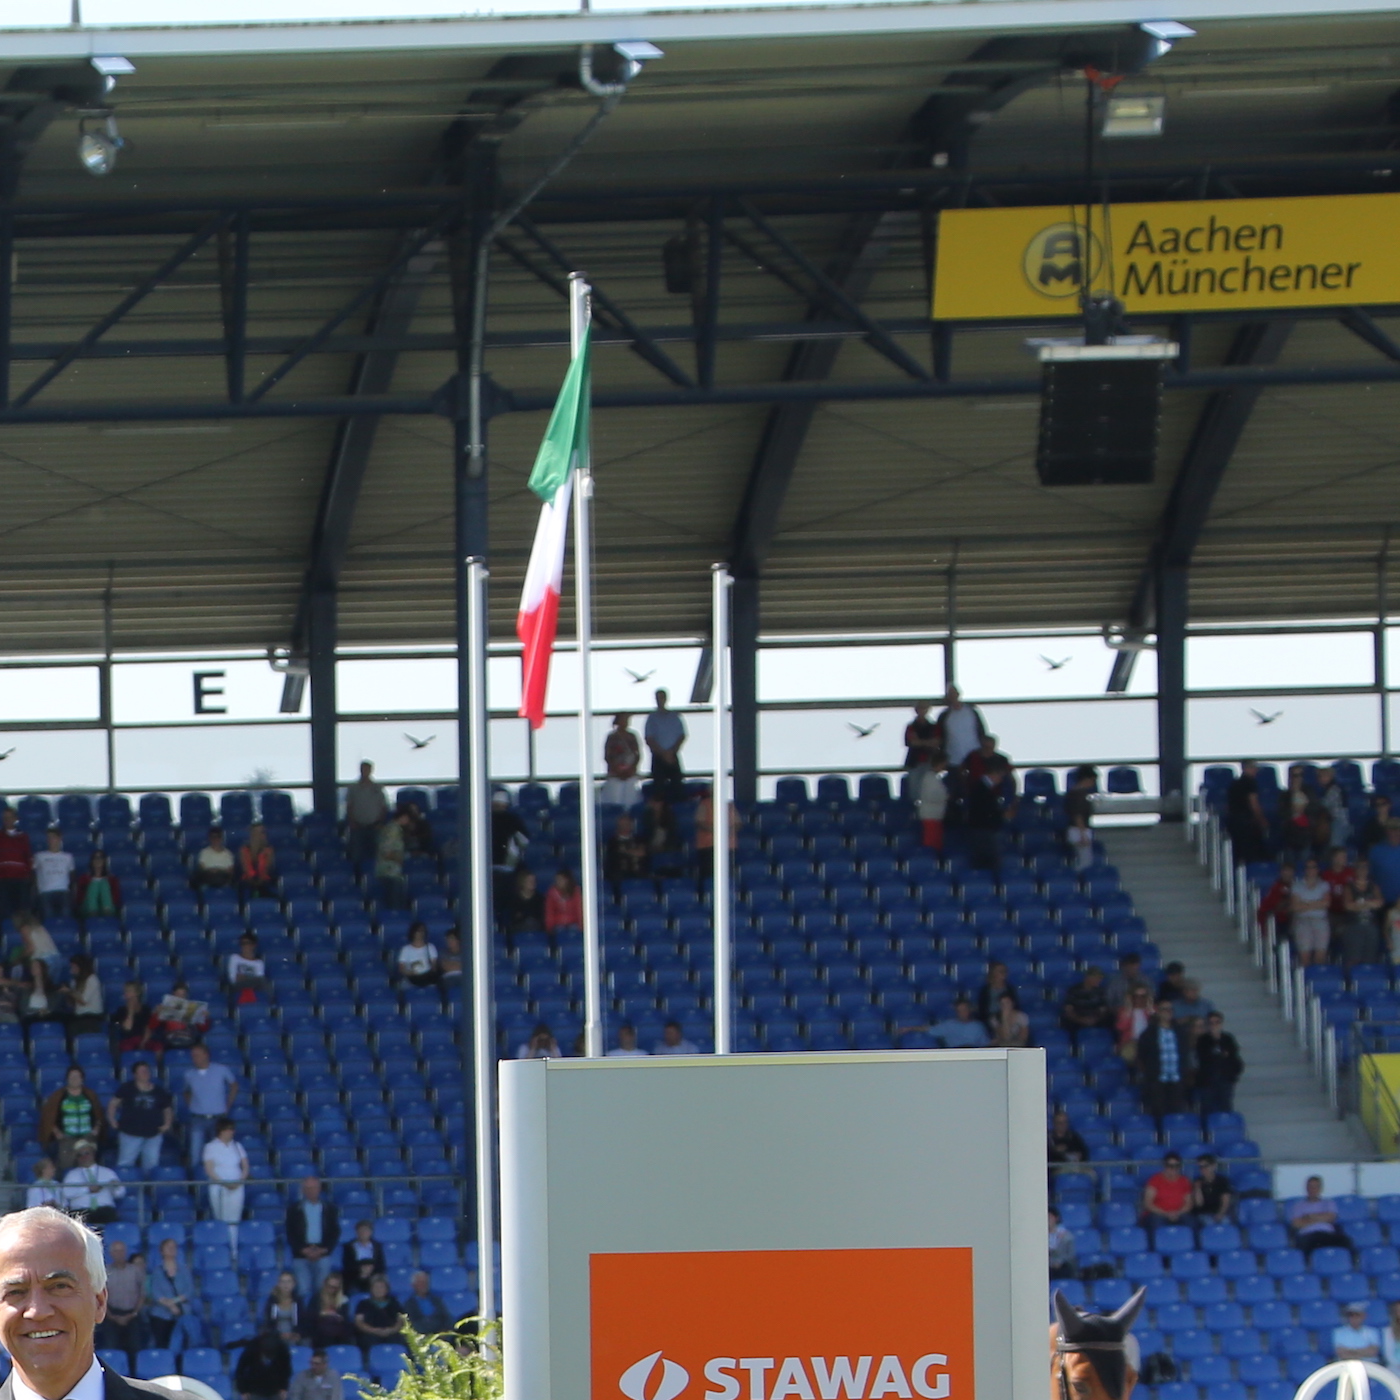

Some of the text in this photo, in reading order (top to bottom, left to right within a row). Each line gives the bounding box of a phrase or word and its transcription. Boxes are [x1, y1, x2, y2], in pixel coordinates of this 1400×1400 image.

[1126, 215, 1284, 255] Aachen
[1122, 257, 1362, 296] Münchener
[192, 670, 227, 714] E
